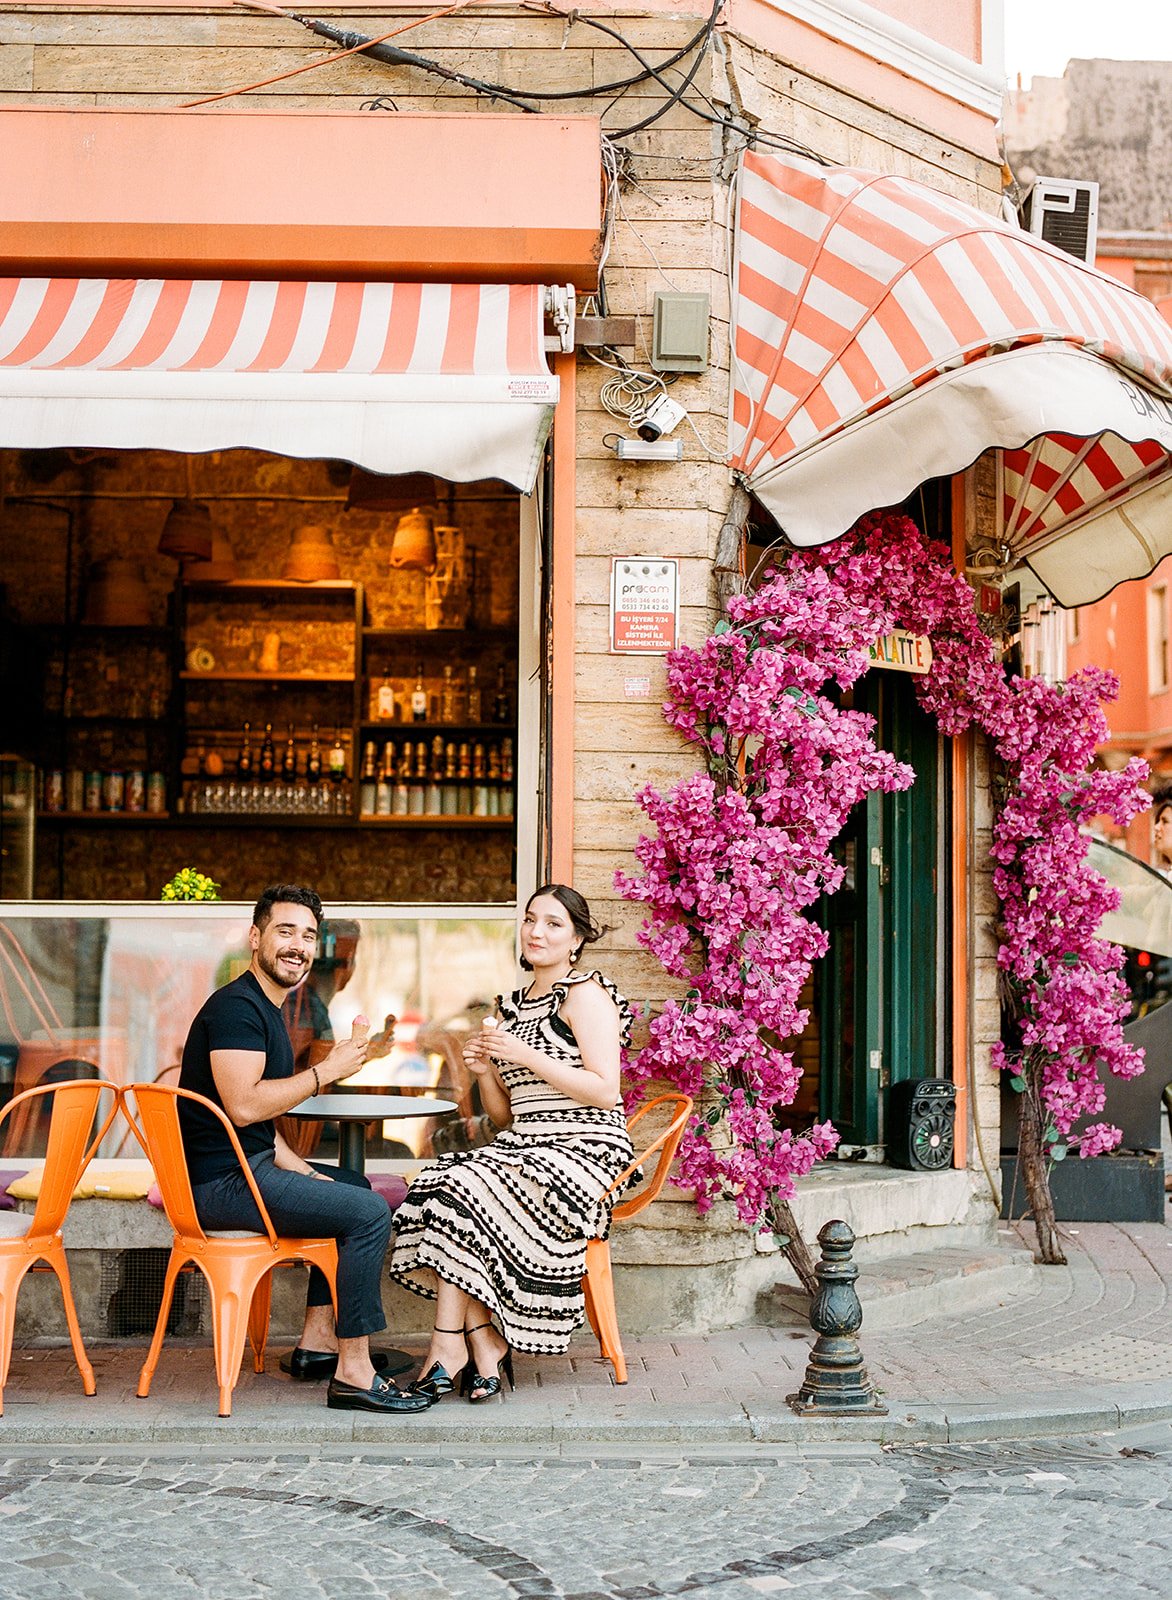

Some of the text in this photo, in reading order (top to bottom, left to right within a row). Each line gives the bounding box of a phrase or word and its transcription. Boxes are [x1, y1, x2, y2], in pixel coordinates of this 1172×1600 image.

[622, 585, 669, 595] procam
[632, 615, 654, 623] İŞYERİ
[625, 631, 664, 639] SİSTEMİ İLE
[617, 639, 671, 647] İZLENMEKTEDİR
